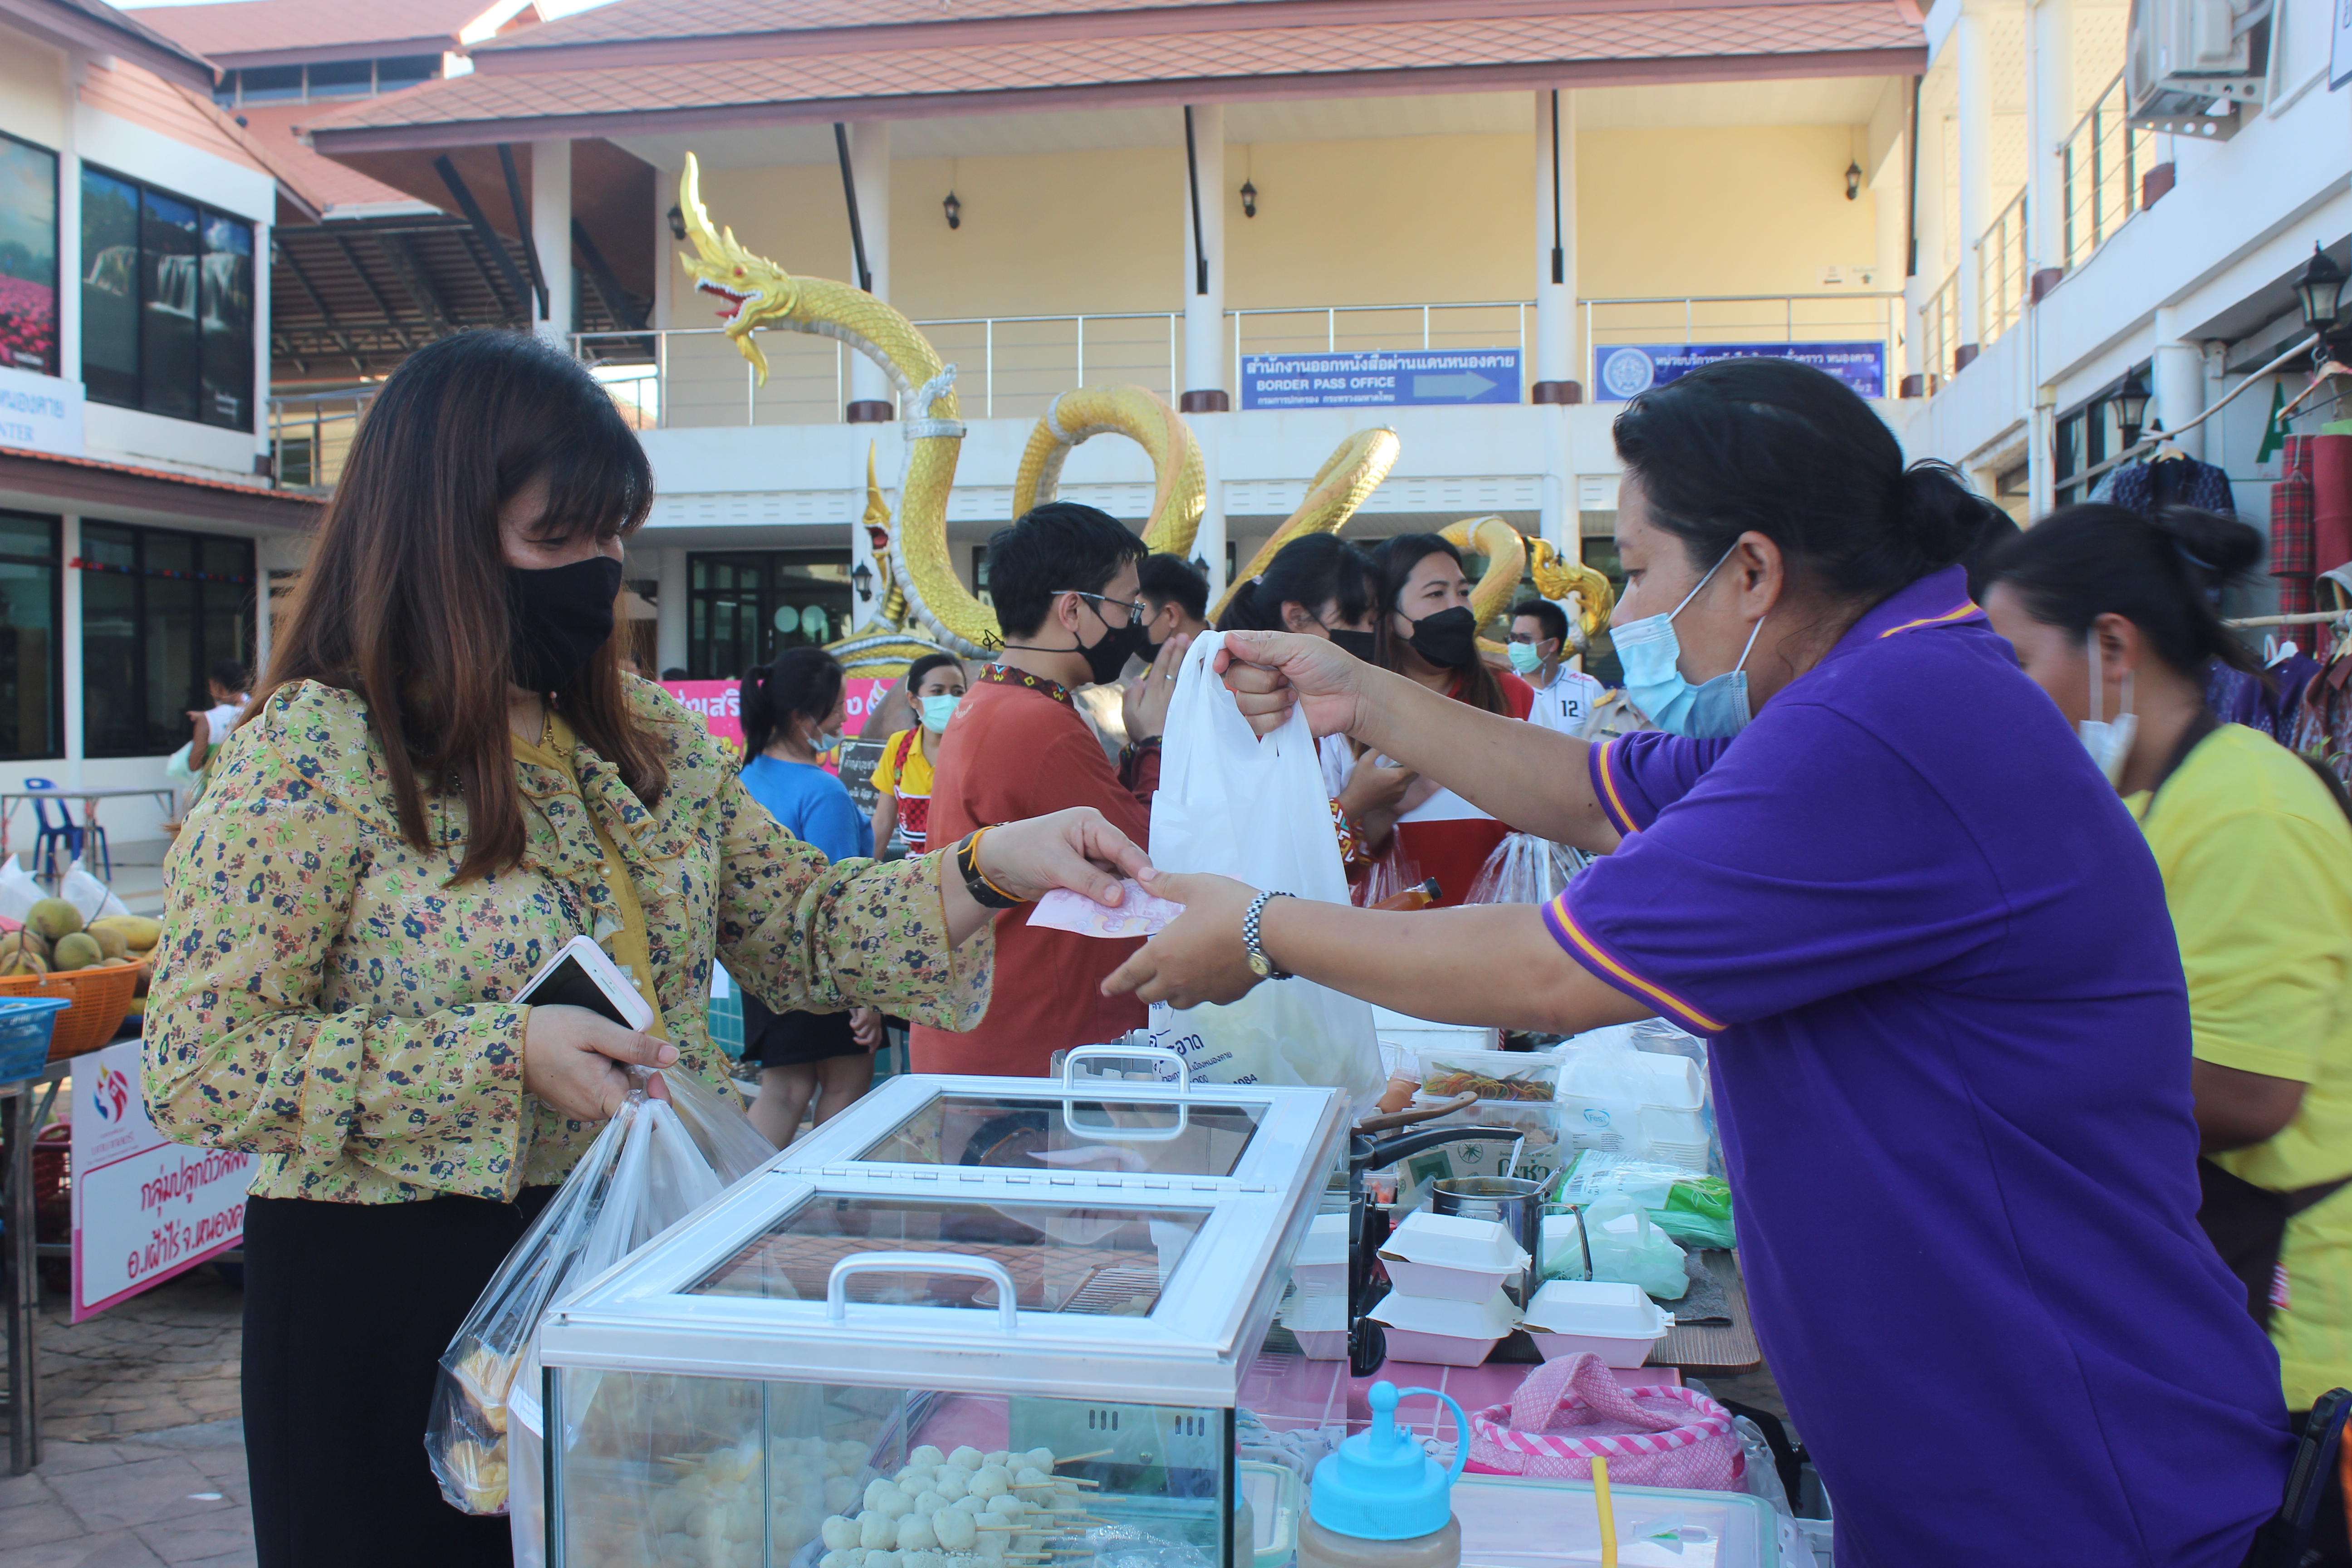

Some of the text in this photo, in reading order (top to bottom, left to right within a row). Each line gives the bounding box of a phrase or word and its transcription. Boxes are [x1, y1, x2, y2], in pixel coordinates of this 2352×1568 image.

[1246, 355, 1515, 374] สำนักงานออกหนังสือผ่านแดนหนองคาย
[1256, 376, 1396, 391] BORDER PASS OFFICE
[0, 389, 65, 419] นองคาย
[1561, 700, 1579, 717] 12
[183, 1201, 248, 1252] จ.หนองค
